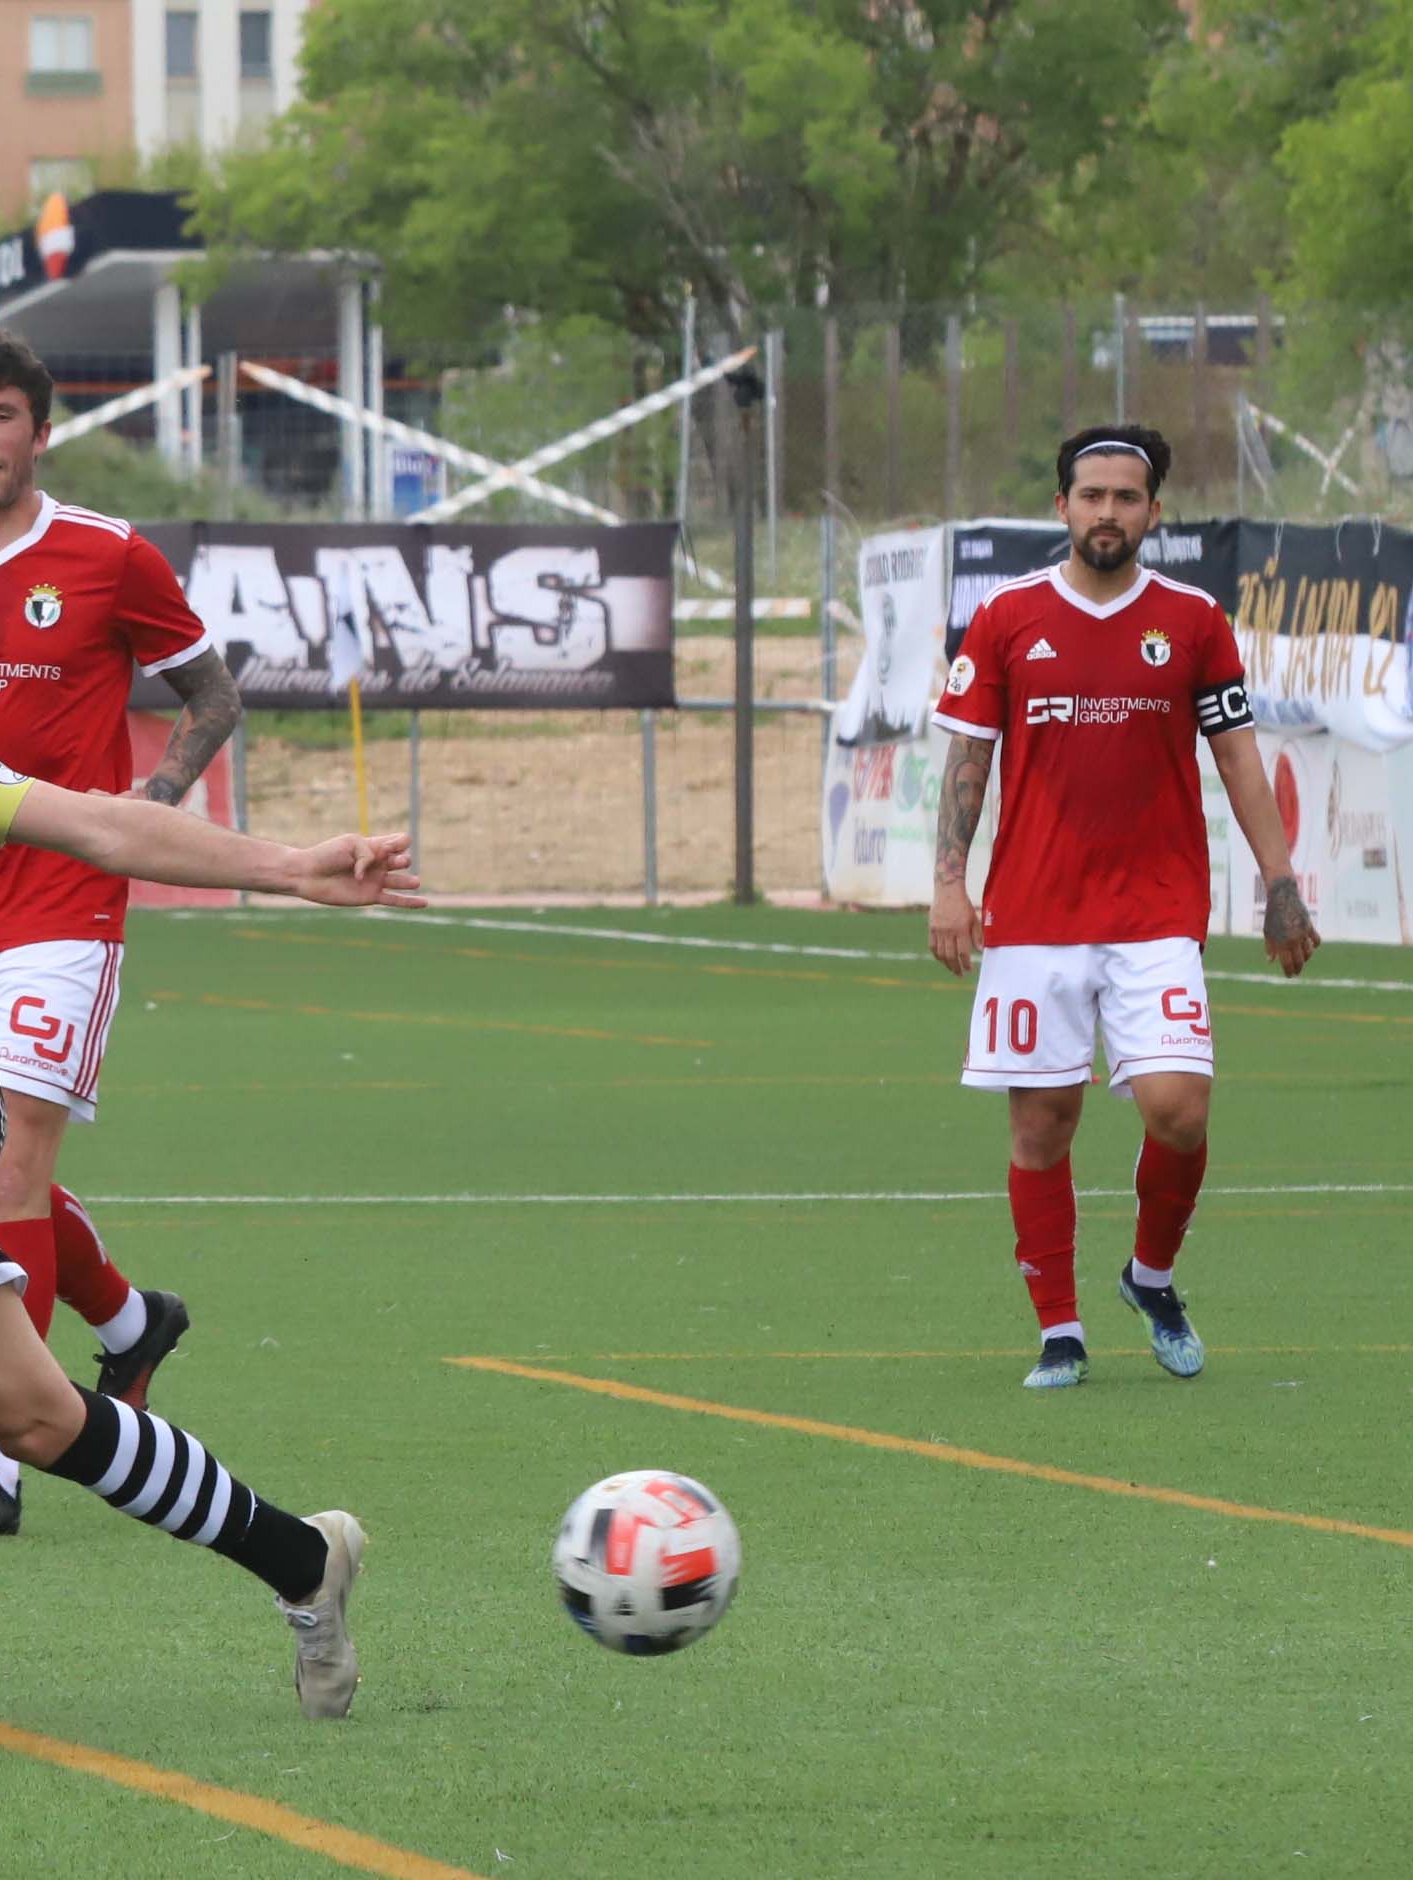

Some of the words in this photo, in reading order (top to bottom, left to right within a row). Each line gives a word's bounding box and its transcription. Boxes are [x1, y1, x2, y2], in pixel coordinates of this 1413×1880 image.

[1026, 650, 1057, 661] adidas
[1080, 697, 1171, 713] INVESTMENTS
[1079, 711, 1130, 724] GROUP
[982, 996, 1040, 1057] 10
[0, 1046, 69, 1077] Automotive
